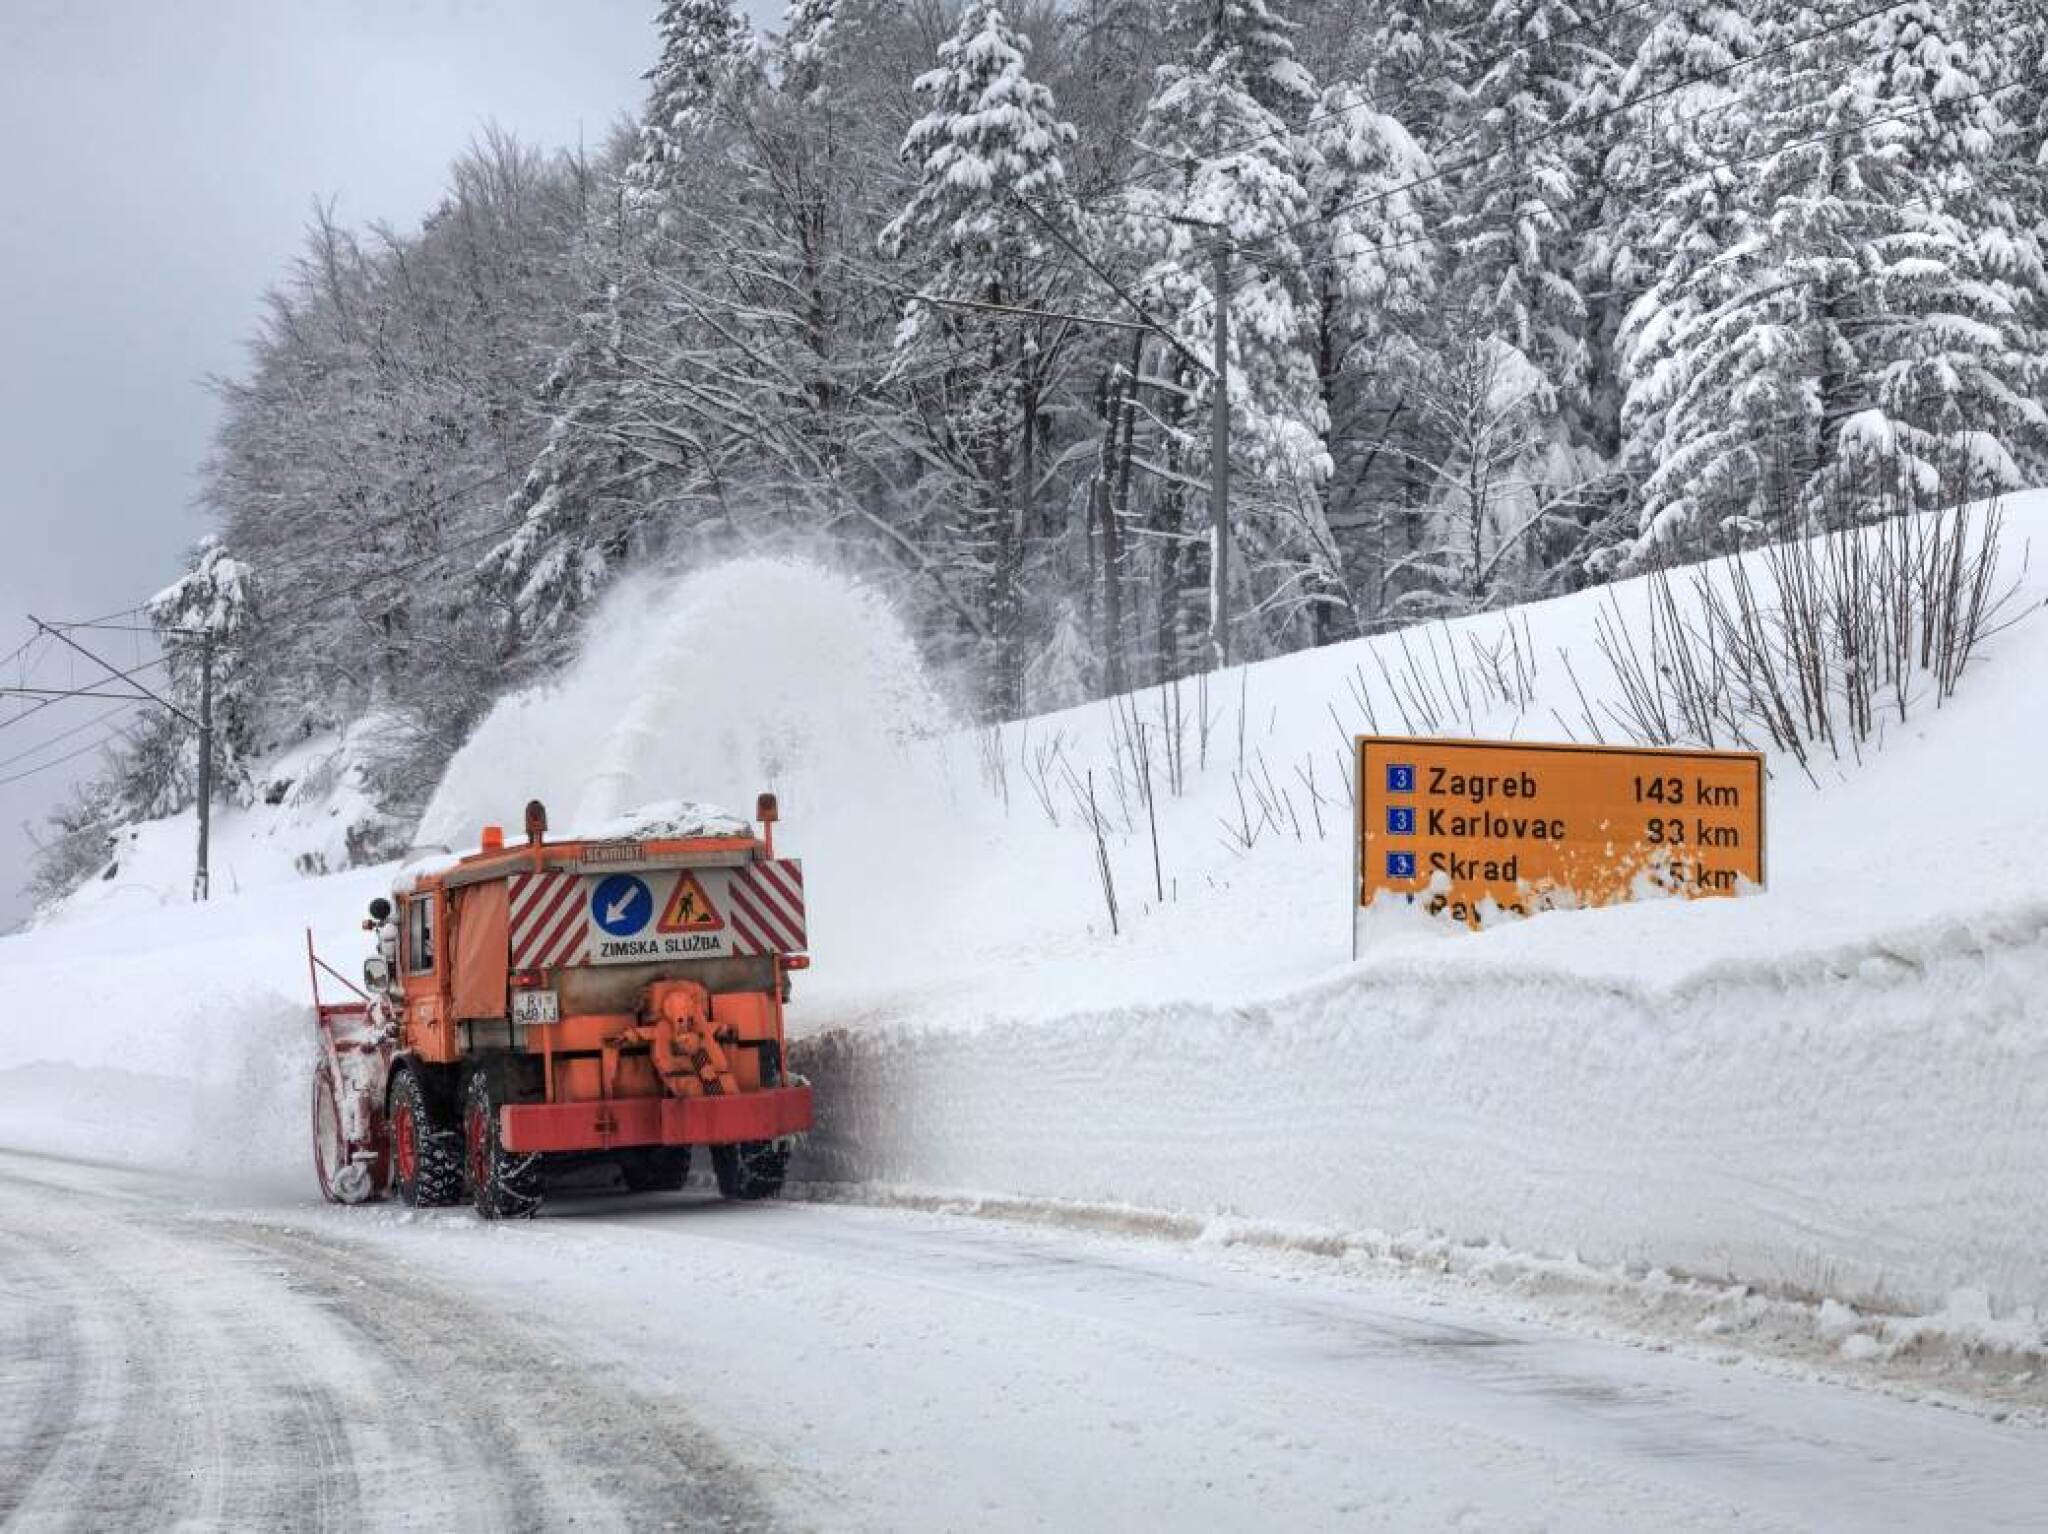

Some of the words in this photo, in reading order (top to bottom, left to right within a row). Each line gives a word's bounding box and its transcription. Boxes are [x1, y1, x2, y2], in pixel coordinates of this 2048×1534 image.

[1429, 767, 1537, 803] Zagreb
[1633, 777, 1684, 804] 143
[1697, 779, 1739, 806] km
[1429, 809, 1565, 841] Karlovac
[1697, 819, 1739, 847] km
[1429, 852, 1517, 881] Skrad
[1696, 863, 1738, 888] km
[600, 941, 659, 958] ZIMSKA
[665, 934, 721, 953] SLUŽBA
